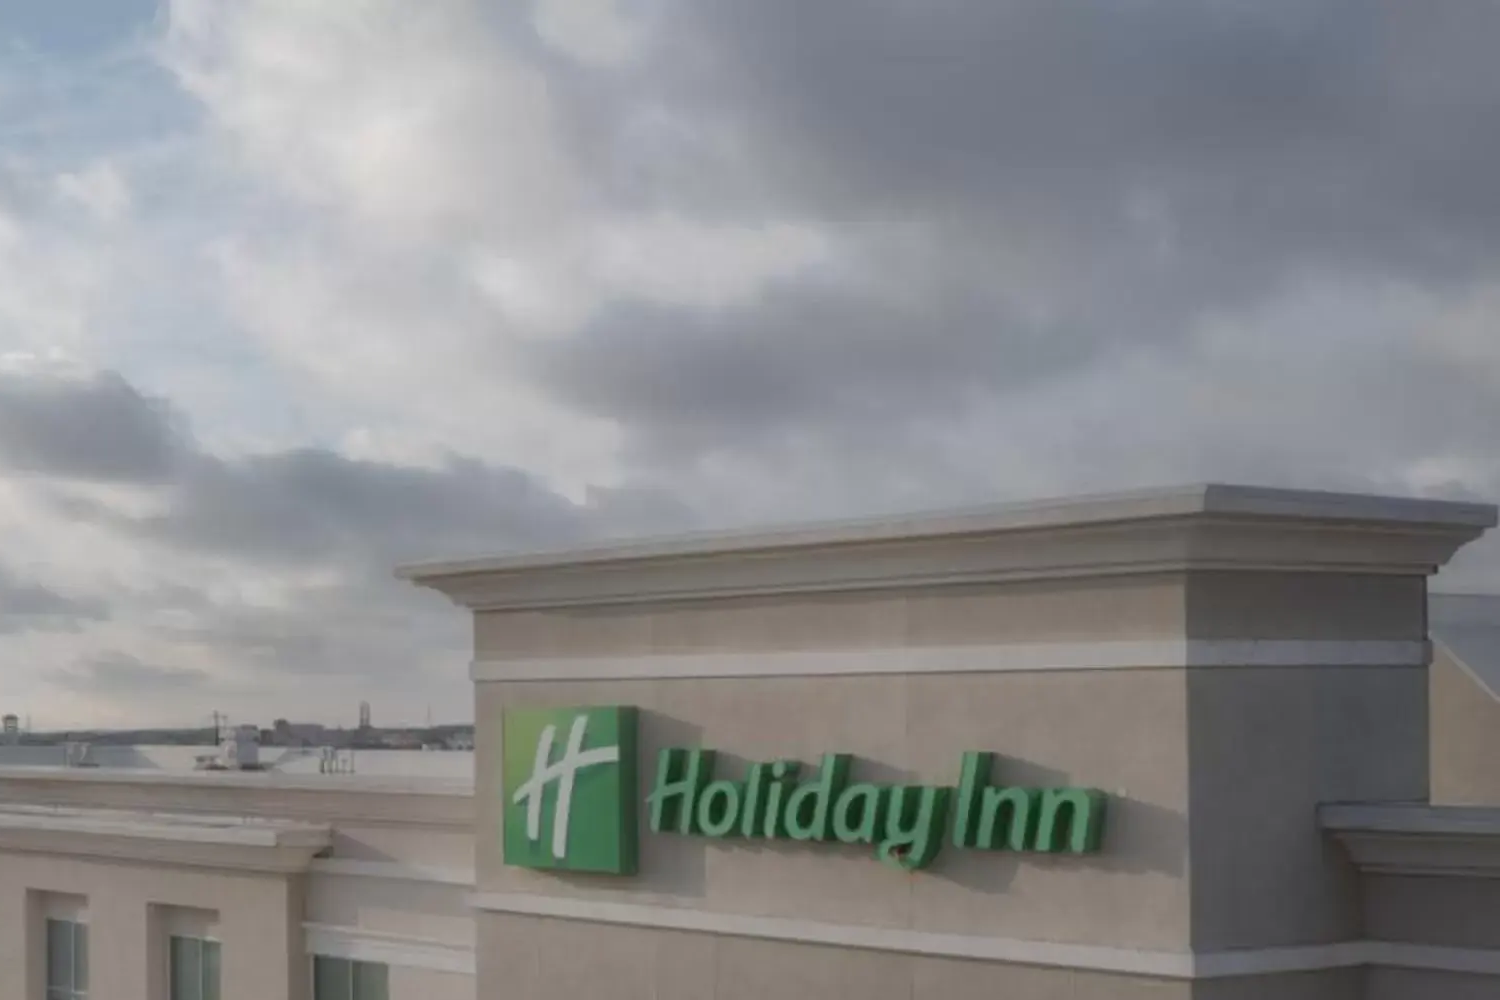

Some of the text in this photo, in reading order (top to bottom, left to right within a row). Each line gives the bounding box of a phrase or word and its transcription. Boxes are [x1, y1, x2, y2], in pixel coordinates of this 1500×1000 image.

[513, 714, 620, 858] H
[646, 748, 1098, 870] Holiday Inn
